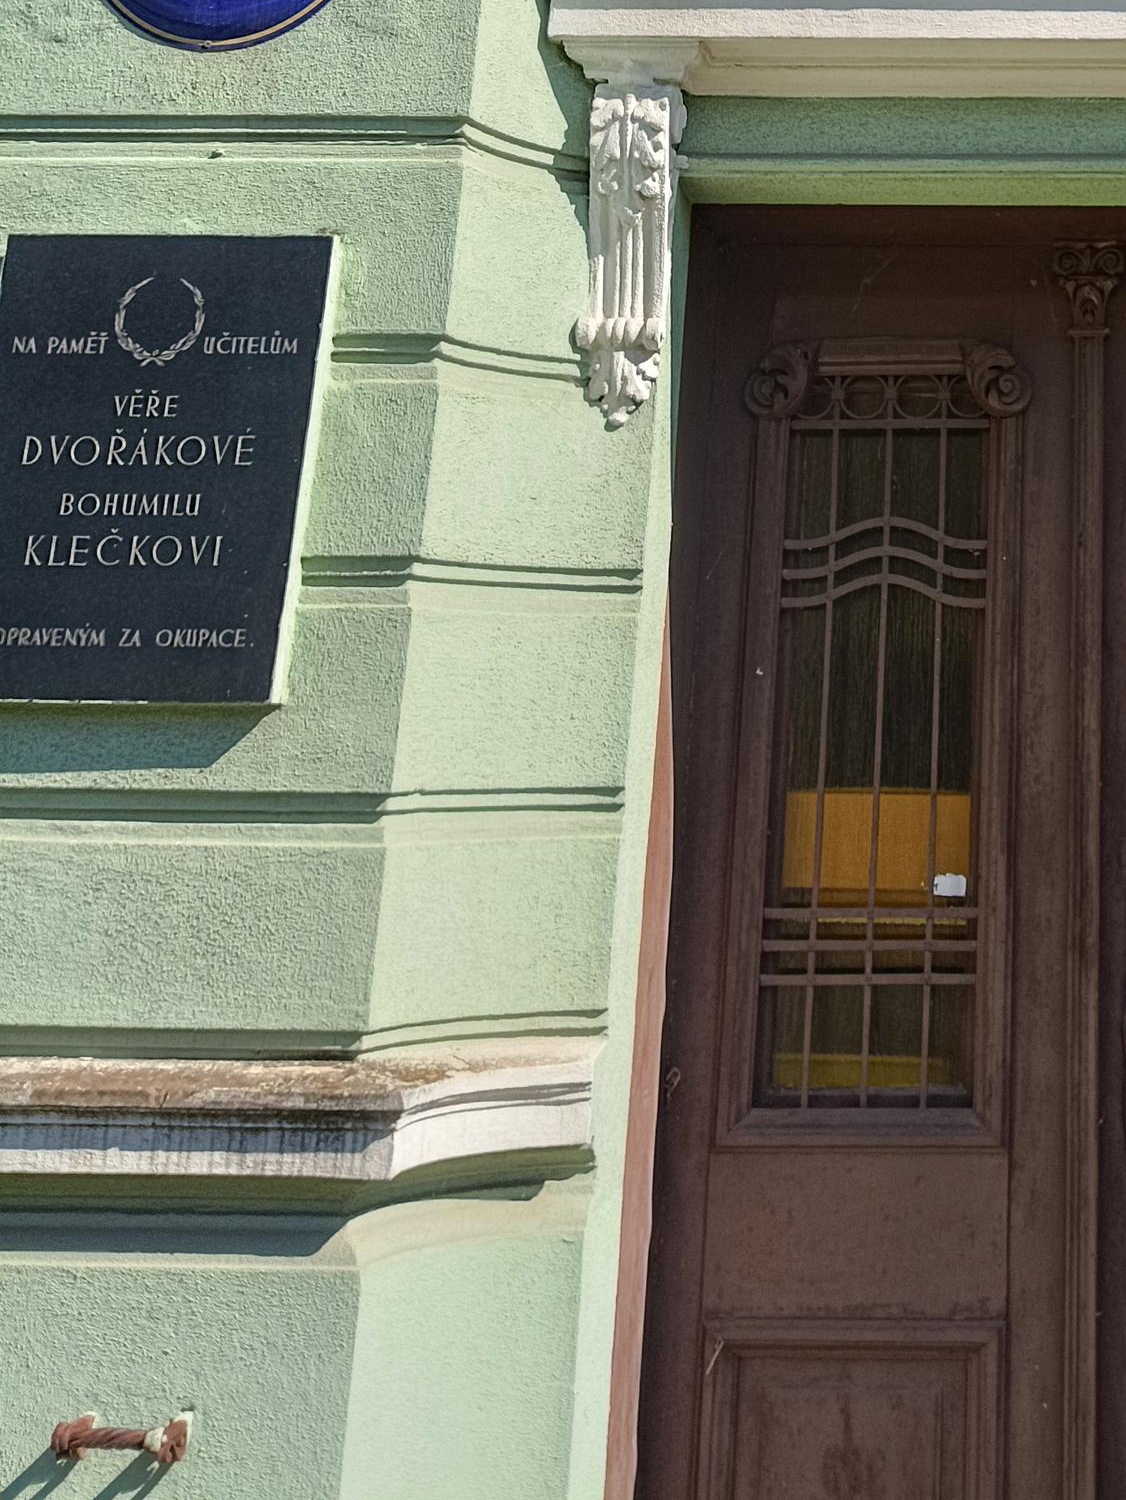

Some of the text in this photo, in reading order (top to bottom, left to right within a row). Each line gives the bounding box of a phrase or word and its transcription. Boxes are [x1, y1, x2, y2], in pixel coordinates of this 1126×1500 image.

[12, 336, 37, 354] NA
[203, 330, 298, 355] UČITELŮM
[114, 389, 180, 418] VĚŘE
[21, 428, 257, 467] DVOŘÁKOVÉ
[59, 492, 202, 517] BOHUMILU
[24, 528, 225, 568] KLEČKOVI
[118, 627, 142, 648] ZA
[156, 628, 255, 649] OKUPACE.
